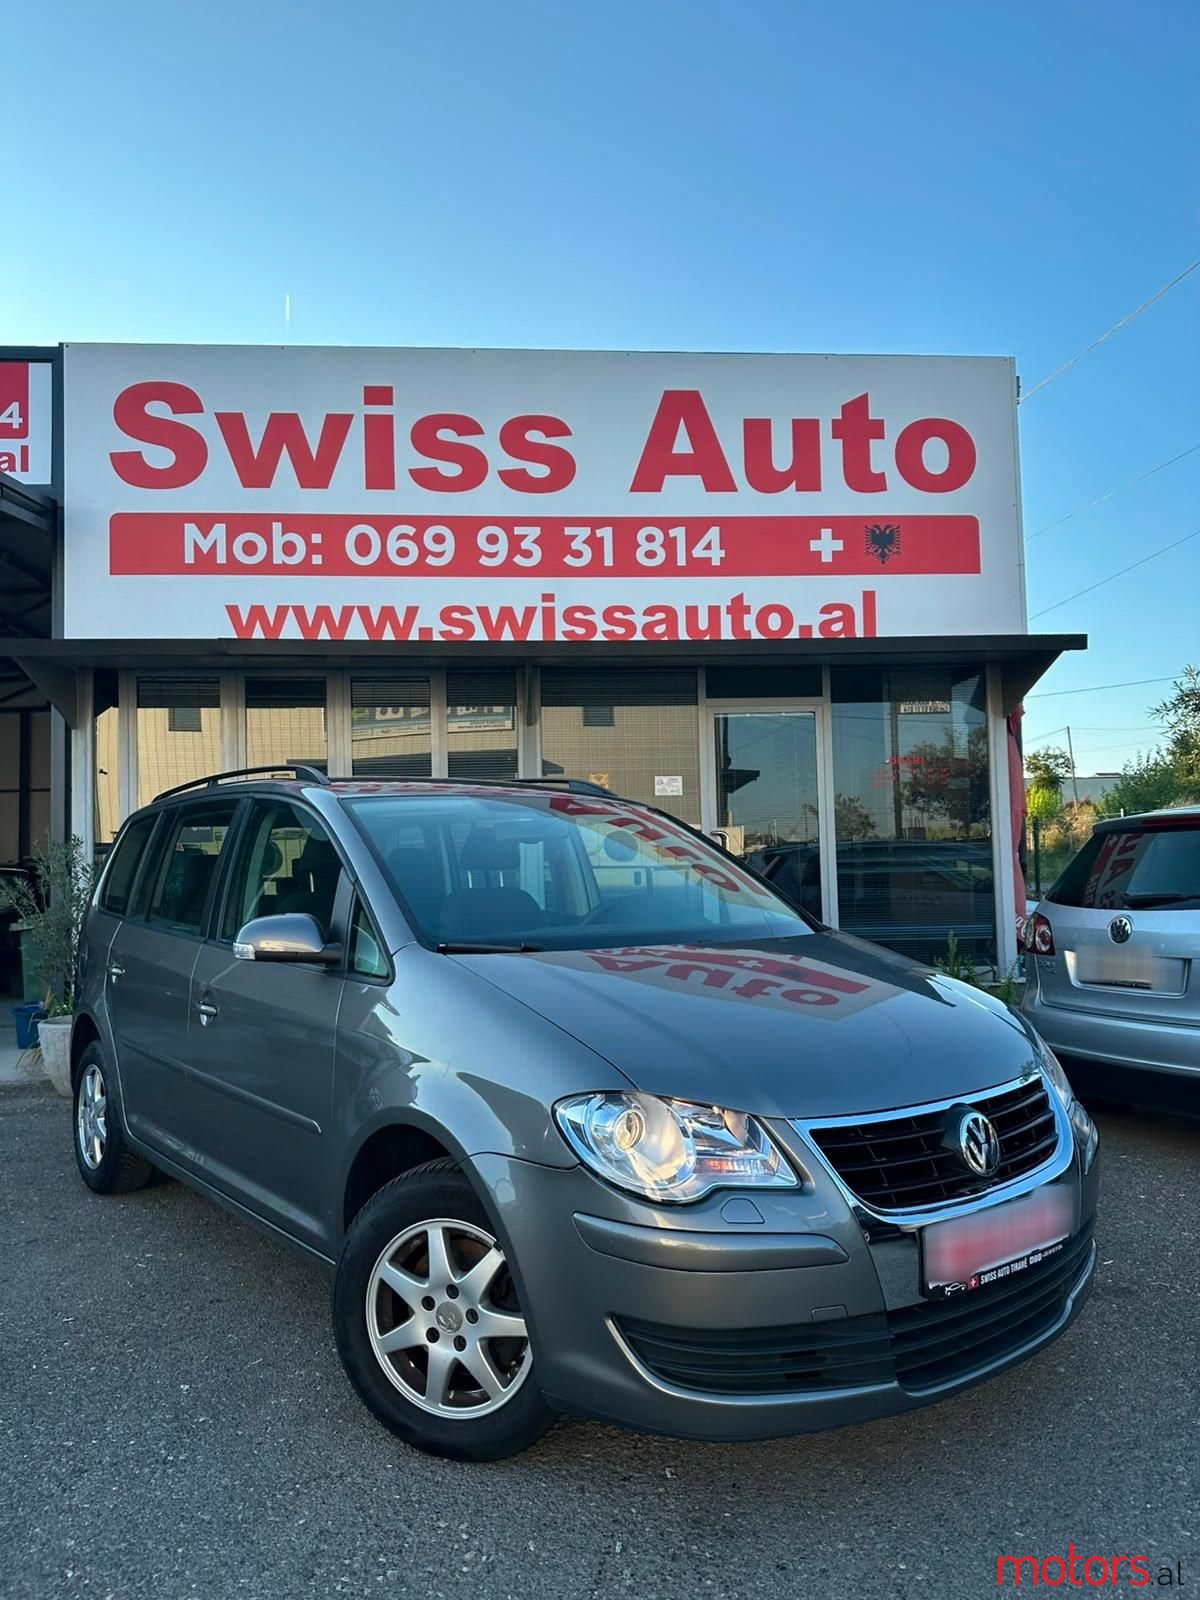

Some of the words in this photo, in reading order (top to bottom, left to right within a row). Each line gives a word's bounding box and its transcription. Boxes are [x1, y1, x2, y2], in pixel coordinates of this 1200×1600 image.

[109, 381, 577, 493] Swiss
[629, 390, 977, 494] Auto
[183, 521, 323, 566] Mob:
[344, 524, 456, 567] 069
[477, 525, 542, 567] 93
[563, 526, 614, 568] 31
[635, 526, 726, 567] 814
[225, 590, 877, 641] www.swissauto.al
